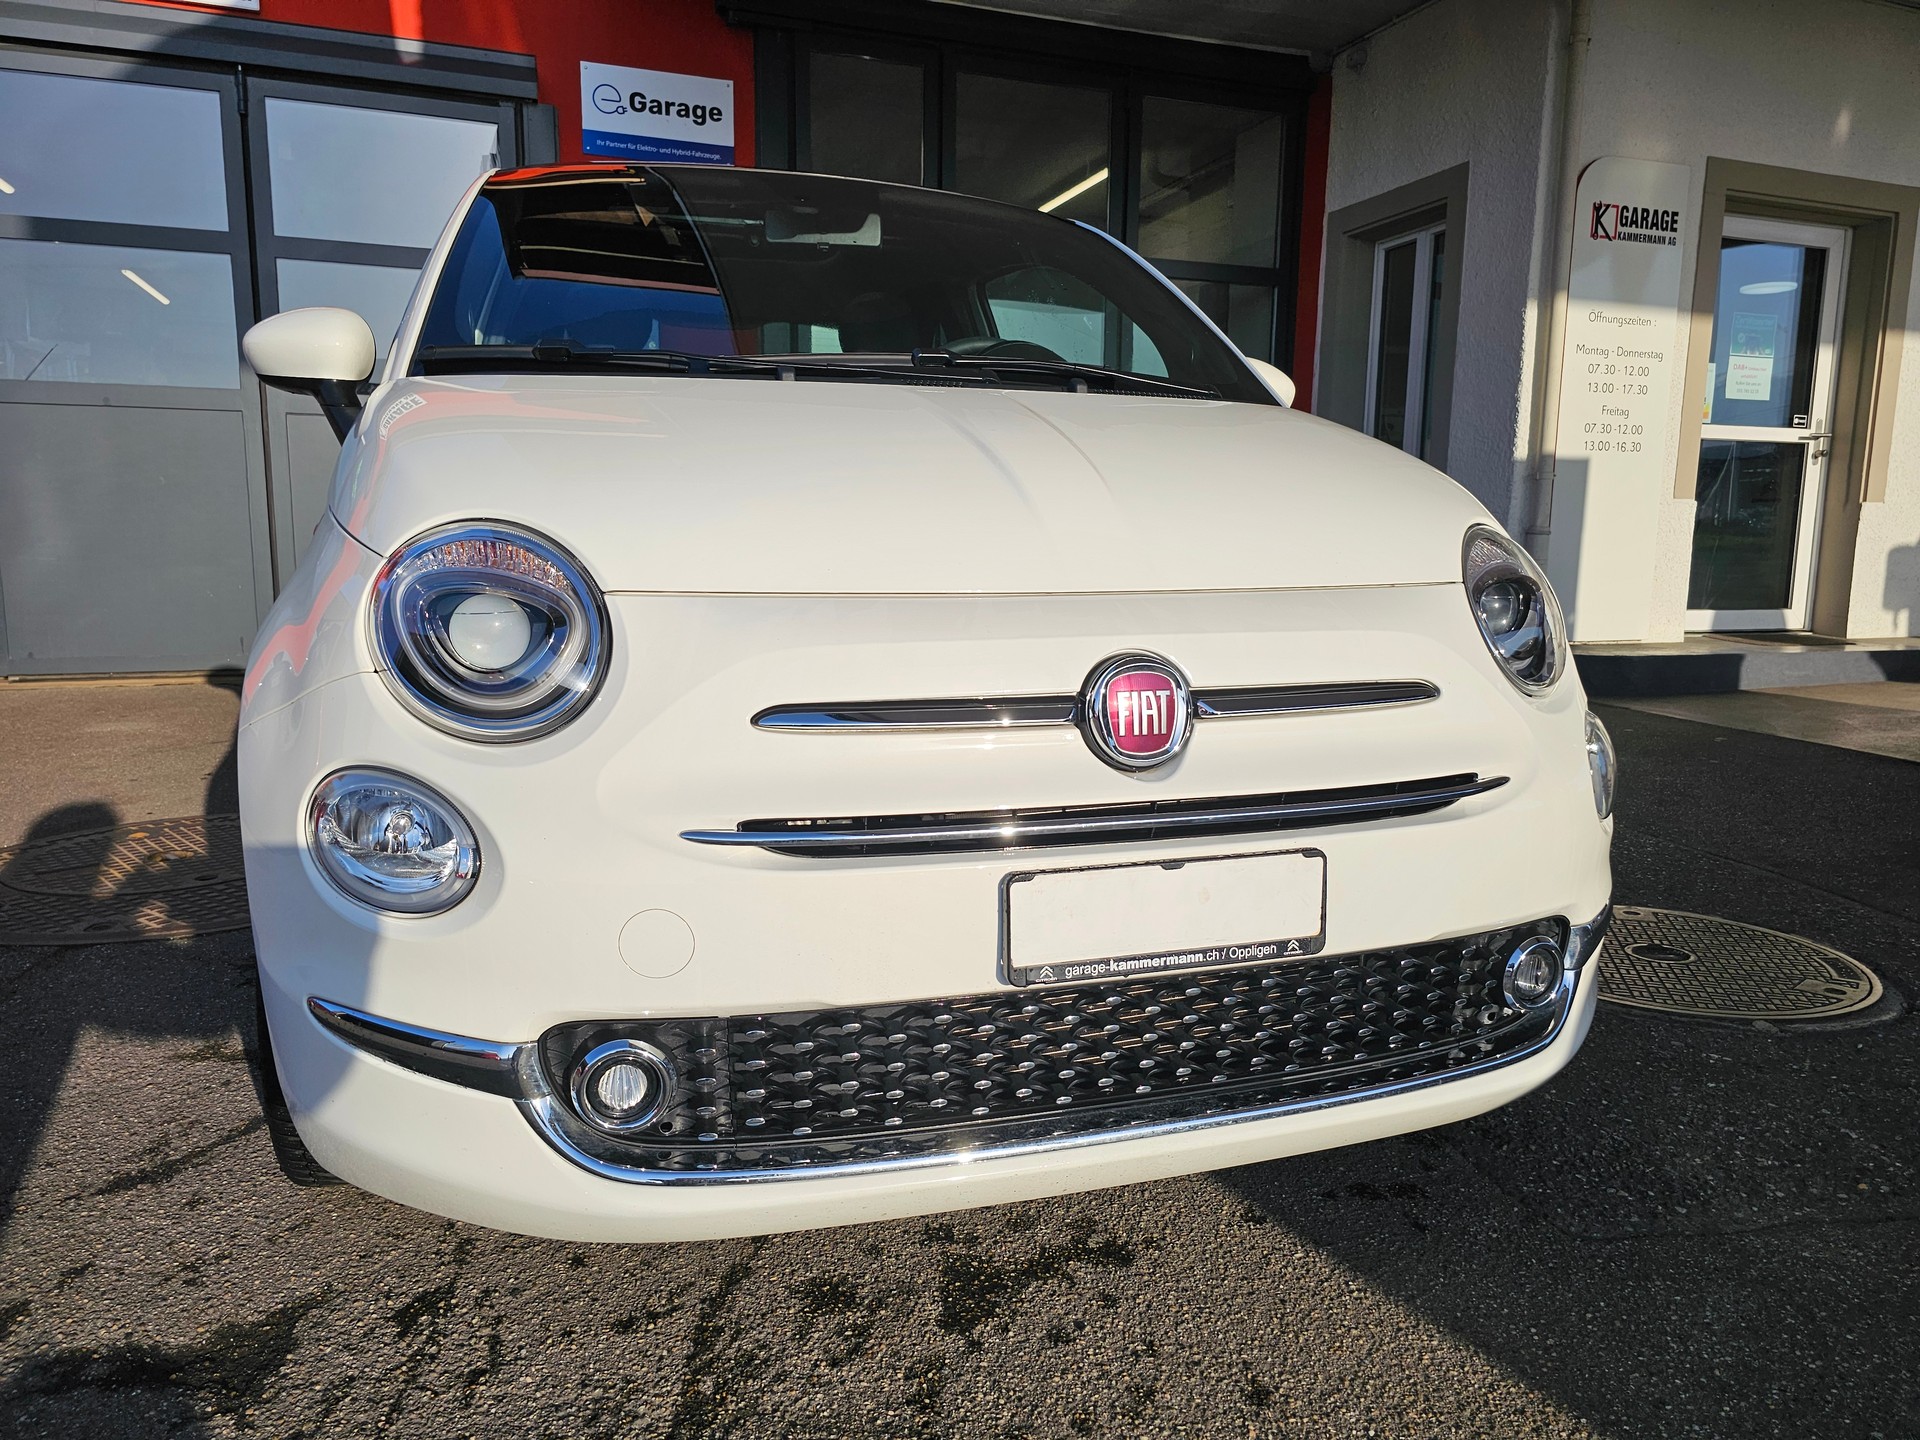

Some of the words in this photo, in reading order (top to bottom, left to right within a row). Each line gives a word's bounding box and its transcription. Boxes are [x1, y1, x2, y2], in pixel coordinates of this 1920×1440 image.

[629, 92, 723, 126] Garage
[605, 140, 627, 149] Partner
[637, 144, 659, 153] Elektro-
[672, 148, 722, 160] Hybrid-Fahrzeuge.
[1619, 205, 1679, 233] GARAGE
[1617, 231, 1666, 246] KAMMERMANN
[1667, 236, 1677, 246] AG
[1588, 309, 1652, 328] Öffnungszeiten
[1575, 344, 1609, 359] Montag
[1616, 346, 1664, 362] Donnerstag
[1588, 363, 1616, 375] 07.30
[1624, 365, 1650, 377] 12.00
[1588, 382, 1614, 394] 13.00
[1623, 384, 1648, 396] 17.30
[1601, 405, 1630, 419] Freitag
[1584, 422, 1612, 434] 07.30
[1584, 440, 1610, 452] 13.00
[1116, 689, 1171, 737] FIAT
[1065, 949, 1219, 979] garage-kammermann.ch
[1229, 943, 1277, 961] Oppligen
